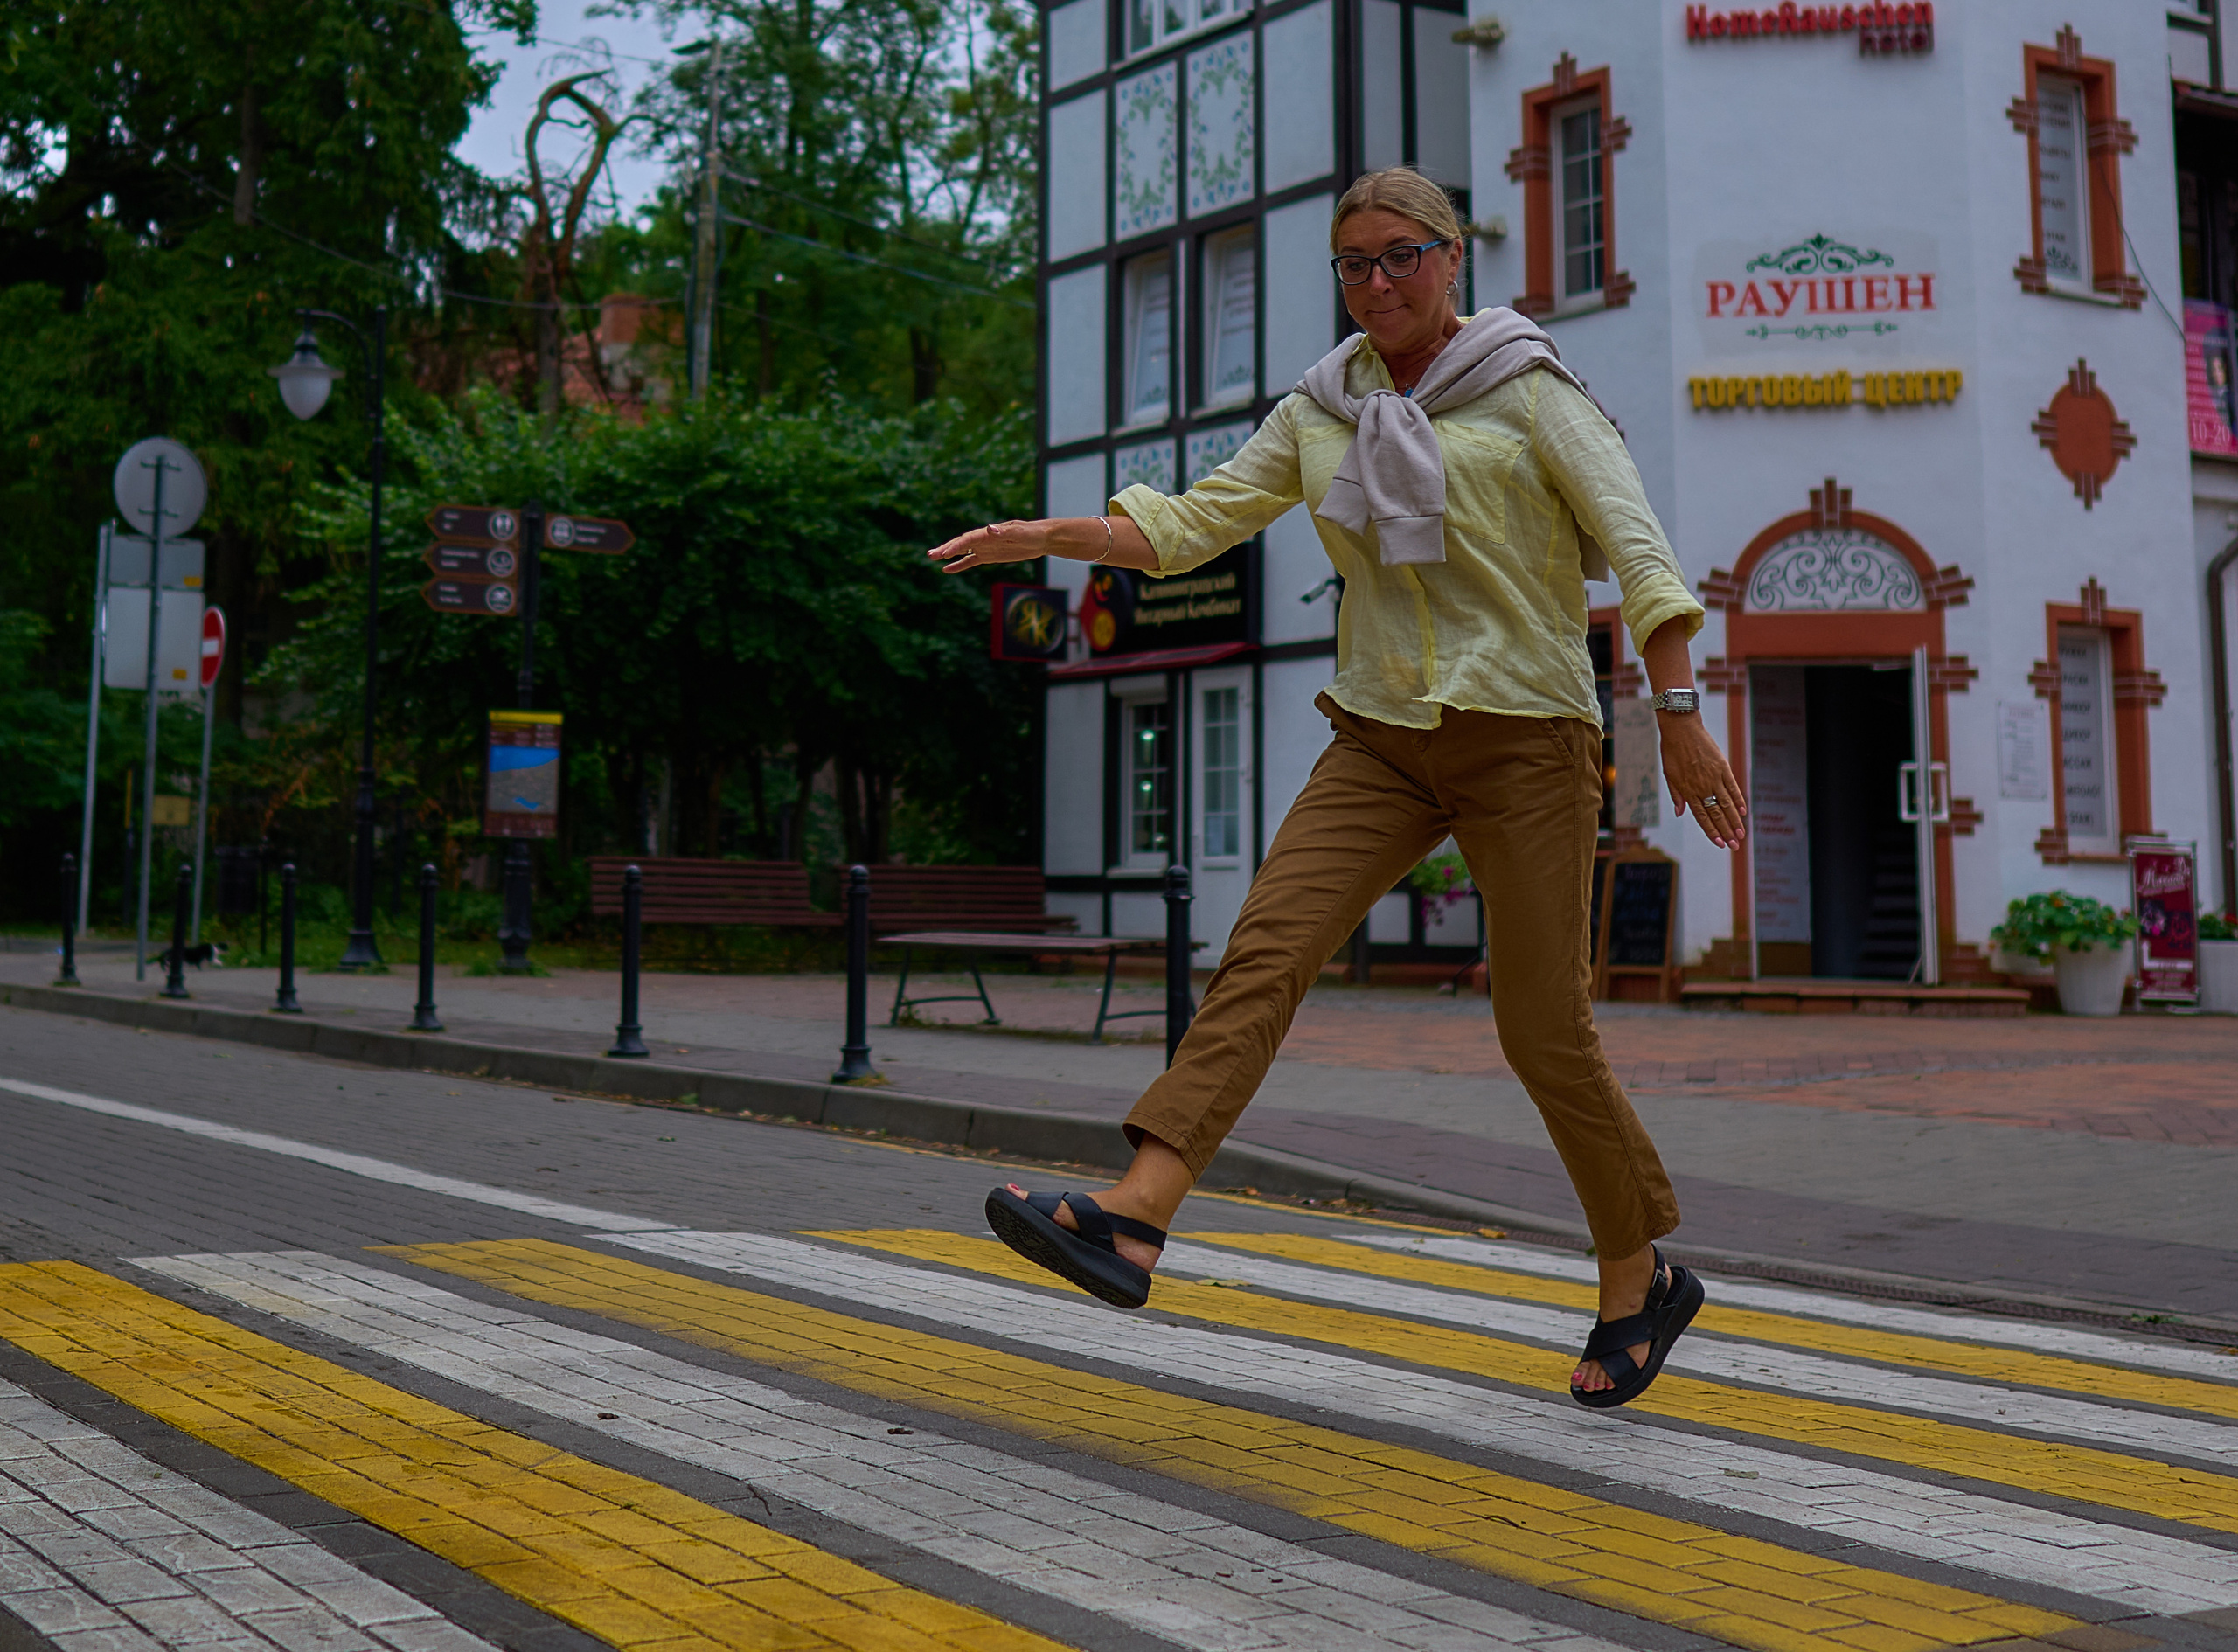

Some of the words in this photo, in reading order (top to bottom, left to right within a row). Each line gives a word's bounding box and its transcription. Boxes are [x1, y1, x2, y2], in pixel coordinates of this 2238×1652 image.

[1706, 273, 1936, 318] РАУШЕН
[1688, 368, 1852, 408] ТОРГОВЫЙ
[1864, 369, 1963, 408] ЦЕНТР
